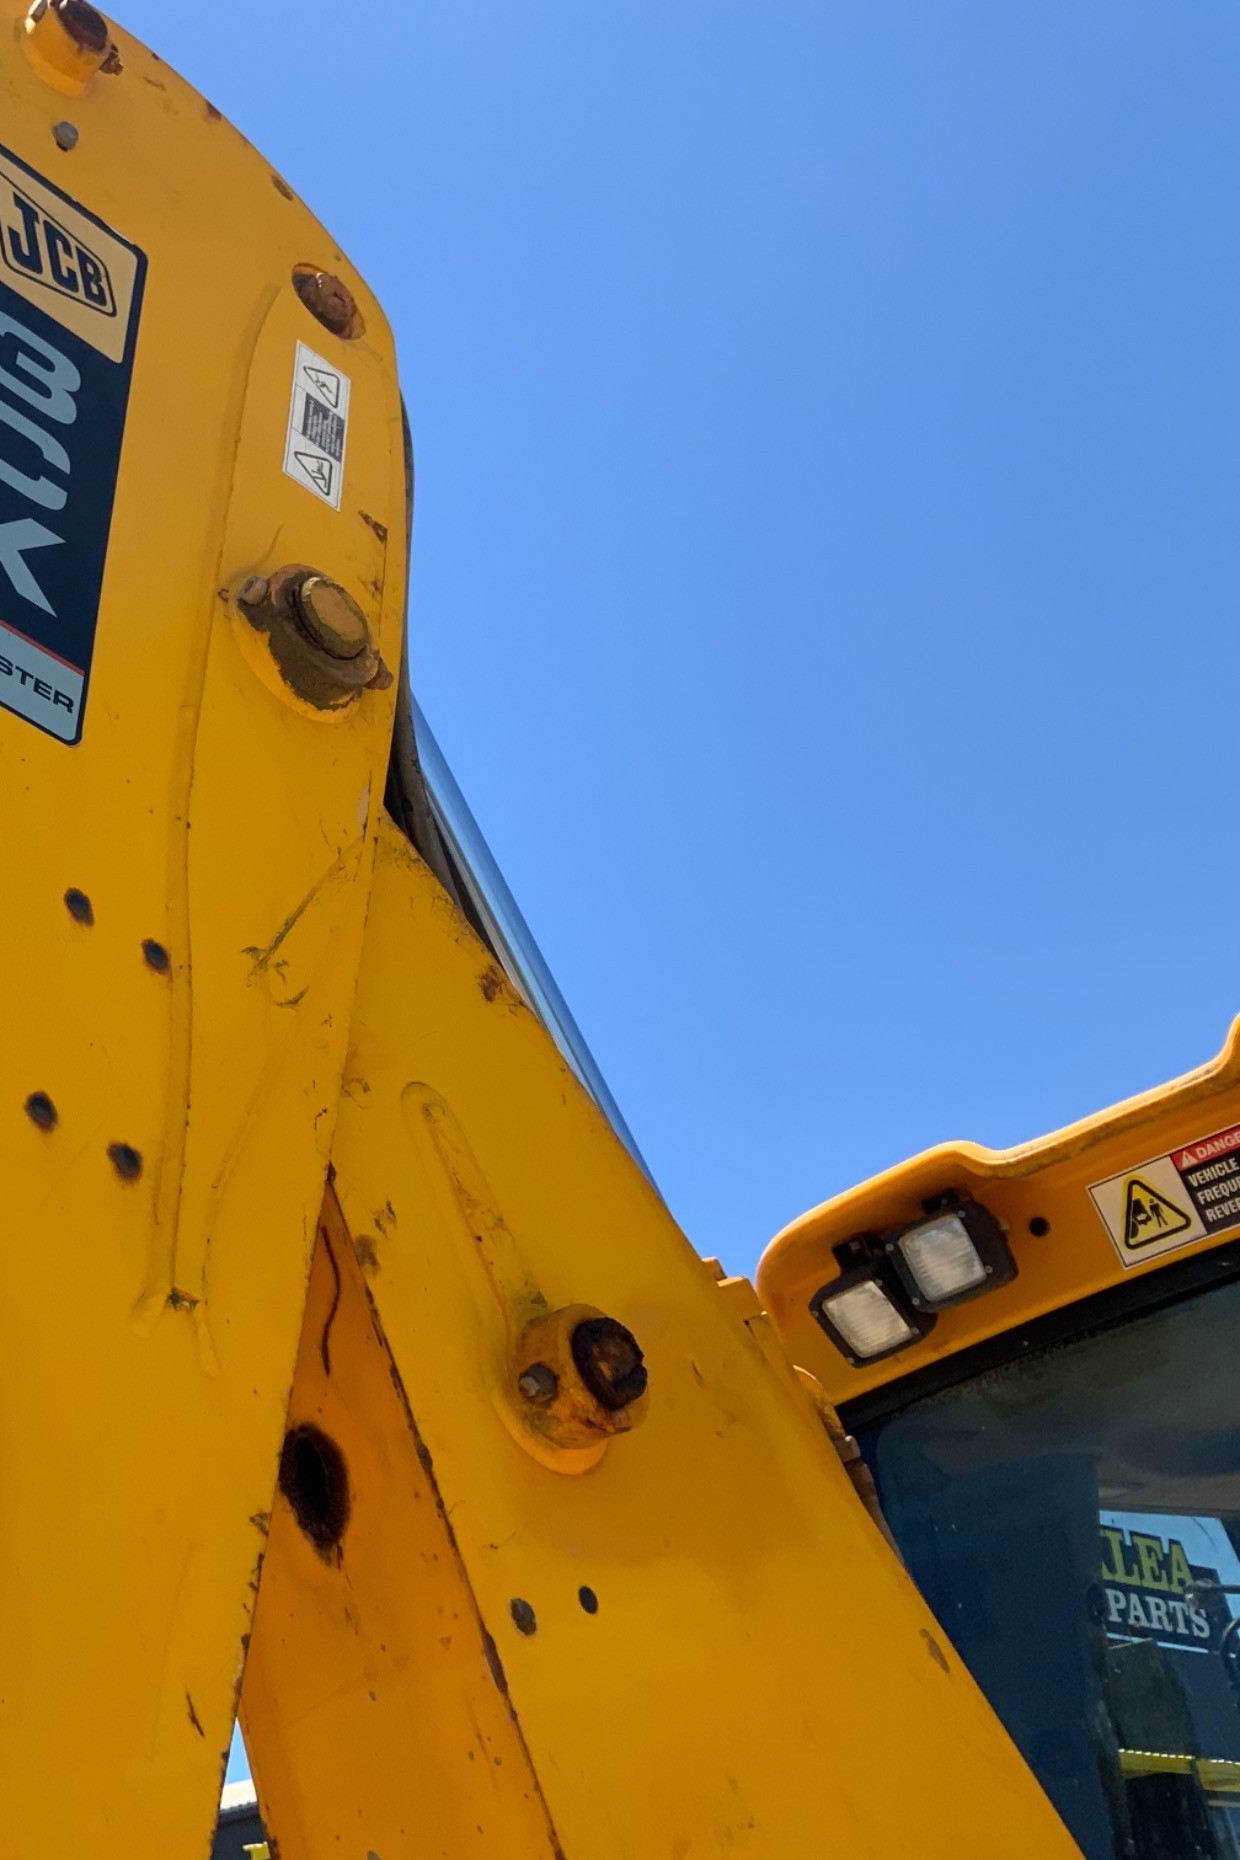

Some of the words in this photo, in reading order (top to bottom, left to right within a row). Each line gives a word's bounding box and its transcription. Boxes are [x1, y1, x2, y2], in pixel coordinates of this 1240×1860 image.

[8, 192, 107, 306] JCB
[1188, 1158, 1240, 1187] VEHICLE
[1101, 1530, 1193, 1594] LEA
[1105, 1589, 1210, 1638] PARTS
